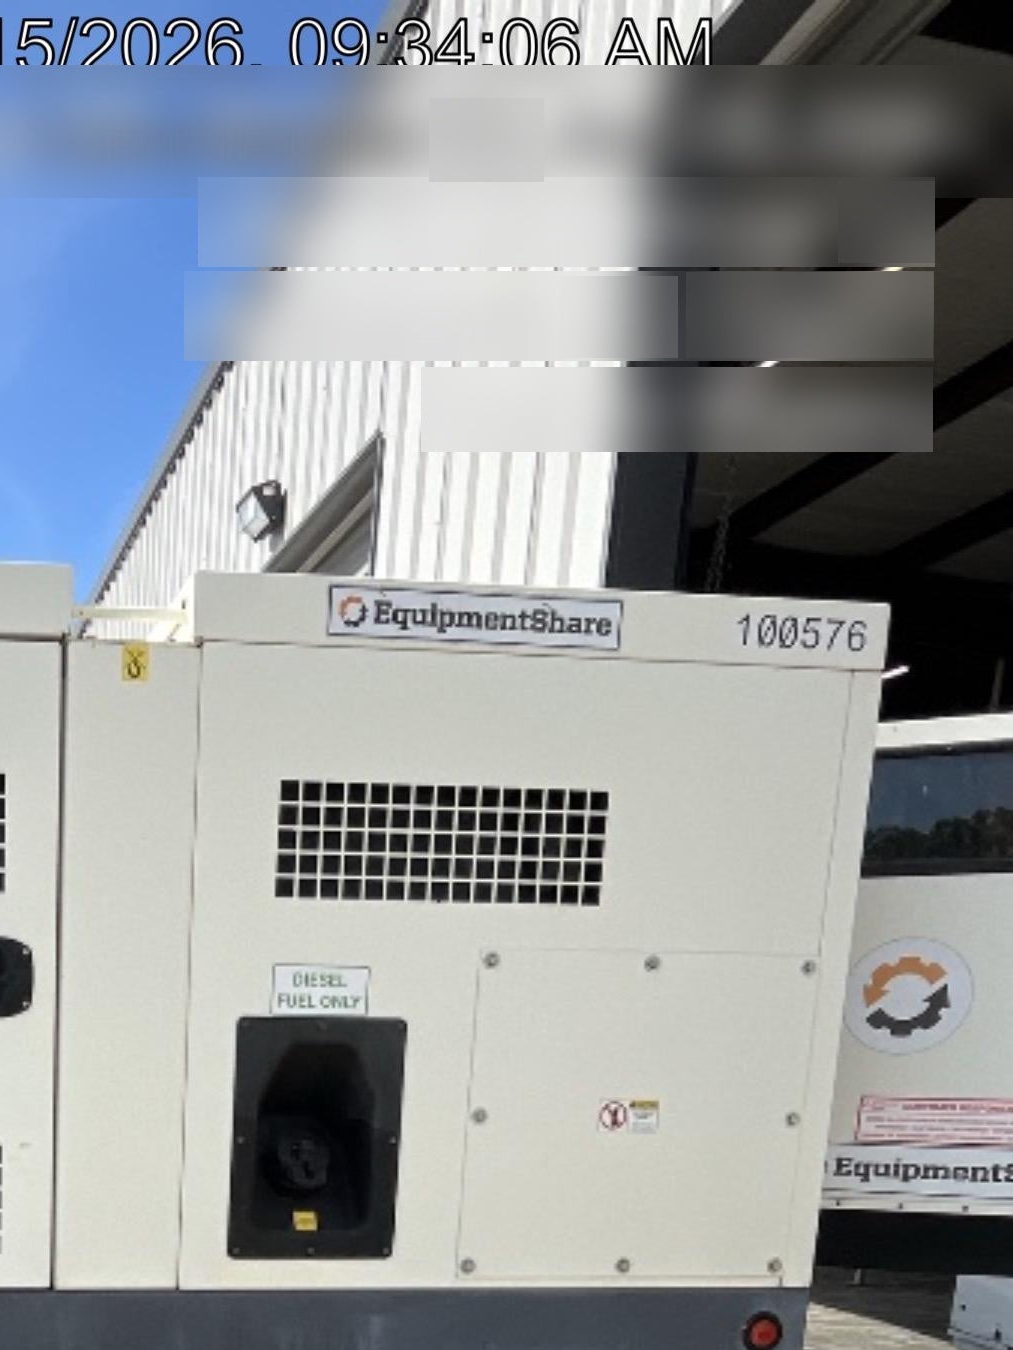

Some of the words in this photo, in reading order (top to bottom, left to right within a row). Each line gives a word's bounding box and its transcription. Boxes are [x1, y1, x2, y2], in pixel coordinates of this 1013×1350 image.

[373, 599, 612, 637] EquipmentShare
[737, 613, 867, 652] 100576
[292, 970, 348, 988] DIESEL
[277, 992, 316, 1009] FUEL
[319, 994, 363, 1009] ONLY
